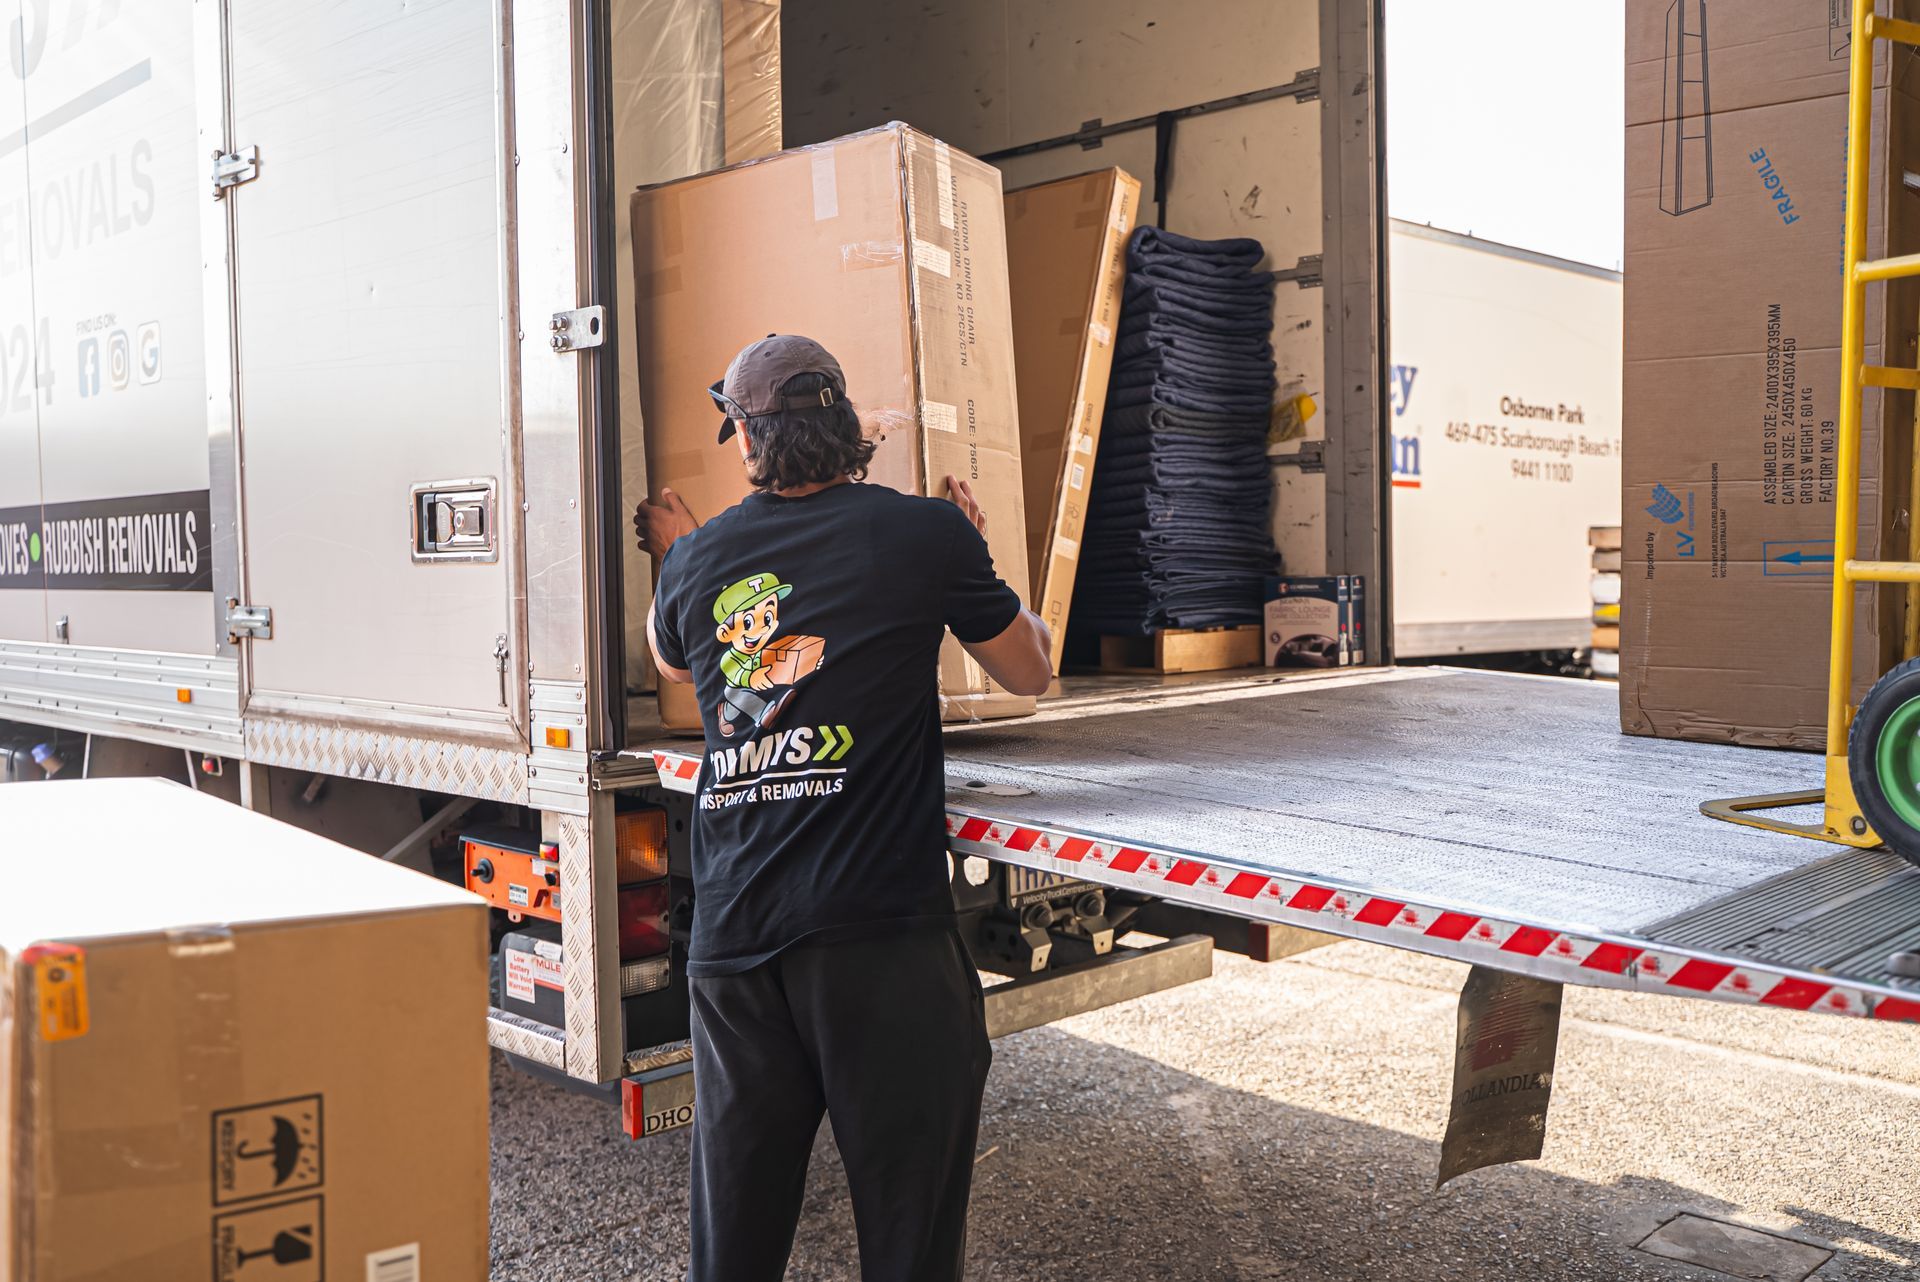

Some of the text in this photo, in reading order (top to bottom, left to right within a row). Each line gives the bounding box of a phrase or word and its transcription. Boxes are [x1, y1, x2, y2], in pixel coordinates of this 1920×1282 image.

[950, 175, 958, 206] WITH
[1750, 147, 1800, 225] FRAGILE
[960, 201, 976, 345] RAVONA DINING CHAIR
[956, 283, 964, 300] KD
[957, 305, 968, 367] 2PCS/CTN
[1500, 396, 1585, 424] Osborne Park
[1782, 338, 1796, 504] CARTON SIZE: 2450X450X450
[967, 399, 979, 480] CODE: 75620
[1445, 421, 1498, 447] 469-475
[1500, 426, 1575, 458] Scarborough
[1578, 435, 1611, 458] Beach
[1800, 387, 1813, 504] GROSS WEIGHT: 60 KG
[1510, 458, 1573, 483] 9441 1100
[1763, 442, 1777, 504] ASSEMBLED
[1819, 457, 1833, 502] FACTORY
[43, 518, 104, 575] RUBBISH
[107, 510, 198, 575] REMOVALS
[1645, 531, 1656, 580] Imported by
[1675, 531, 1694, 556] LV
[748, 577, 762, 592] T
[747, 787, 758, 803] &
[762, 778, 843, 802] REMOVALS
[509, 963, 530, 975] Battery
[513, 954, 525, 963] Low
[536, 959, 561, 973] MULE
[508, 981, 532, 995] Warranty
[646, 1103, 696, 1133] DHO
